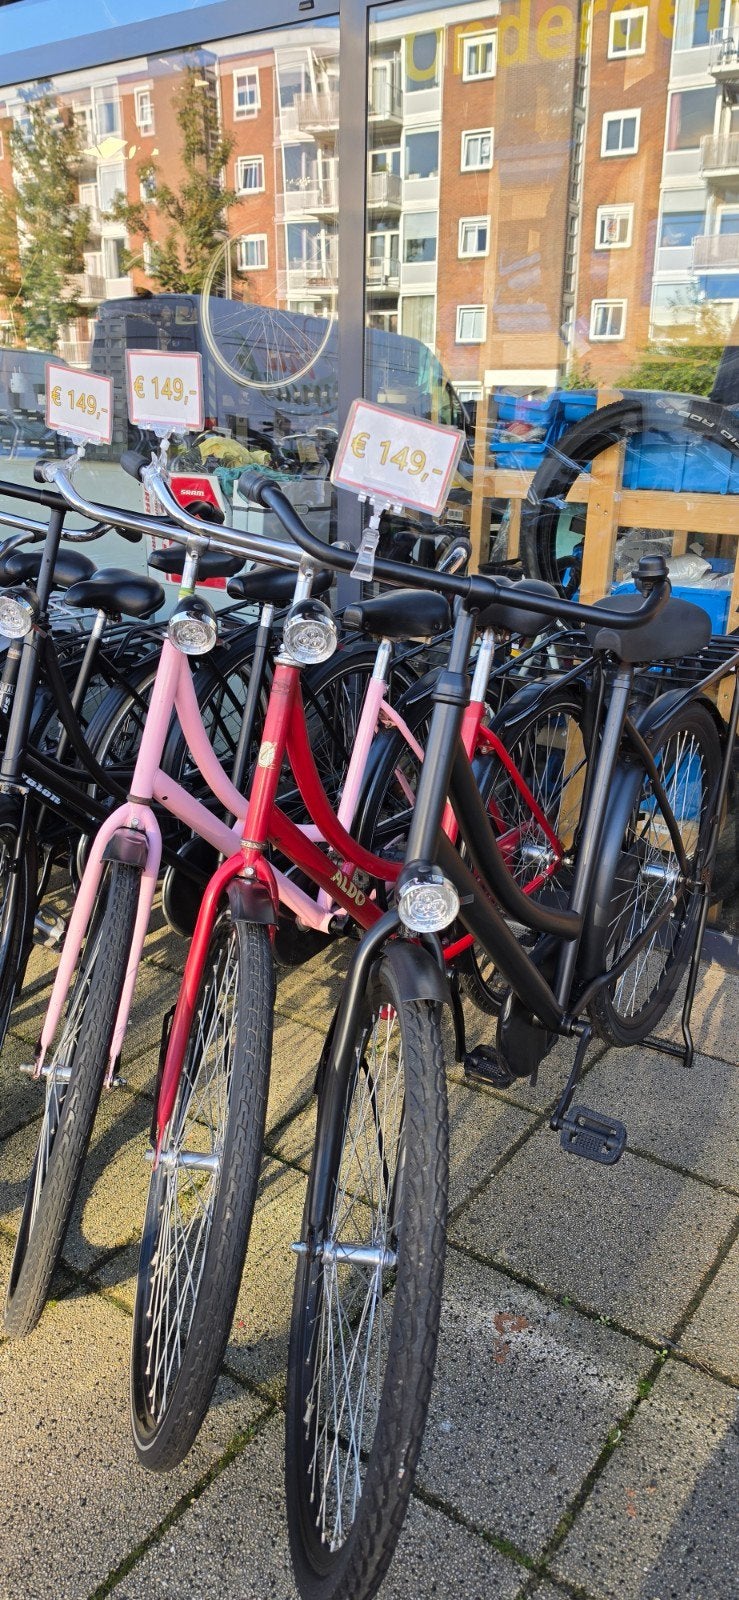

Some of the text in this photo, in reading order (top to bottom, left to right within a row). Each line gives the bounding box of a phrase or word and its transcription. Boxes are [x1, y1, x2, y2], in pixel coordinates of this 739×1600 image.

[51, 385, 109, 420] € 149,-
[133, 375, 197, 404] € 149,-
[350, 431, 443, 483] € 149,-
[180, 488, 205, 497] SRAM
[329, 868, 366, 906] ALDO
